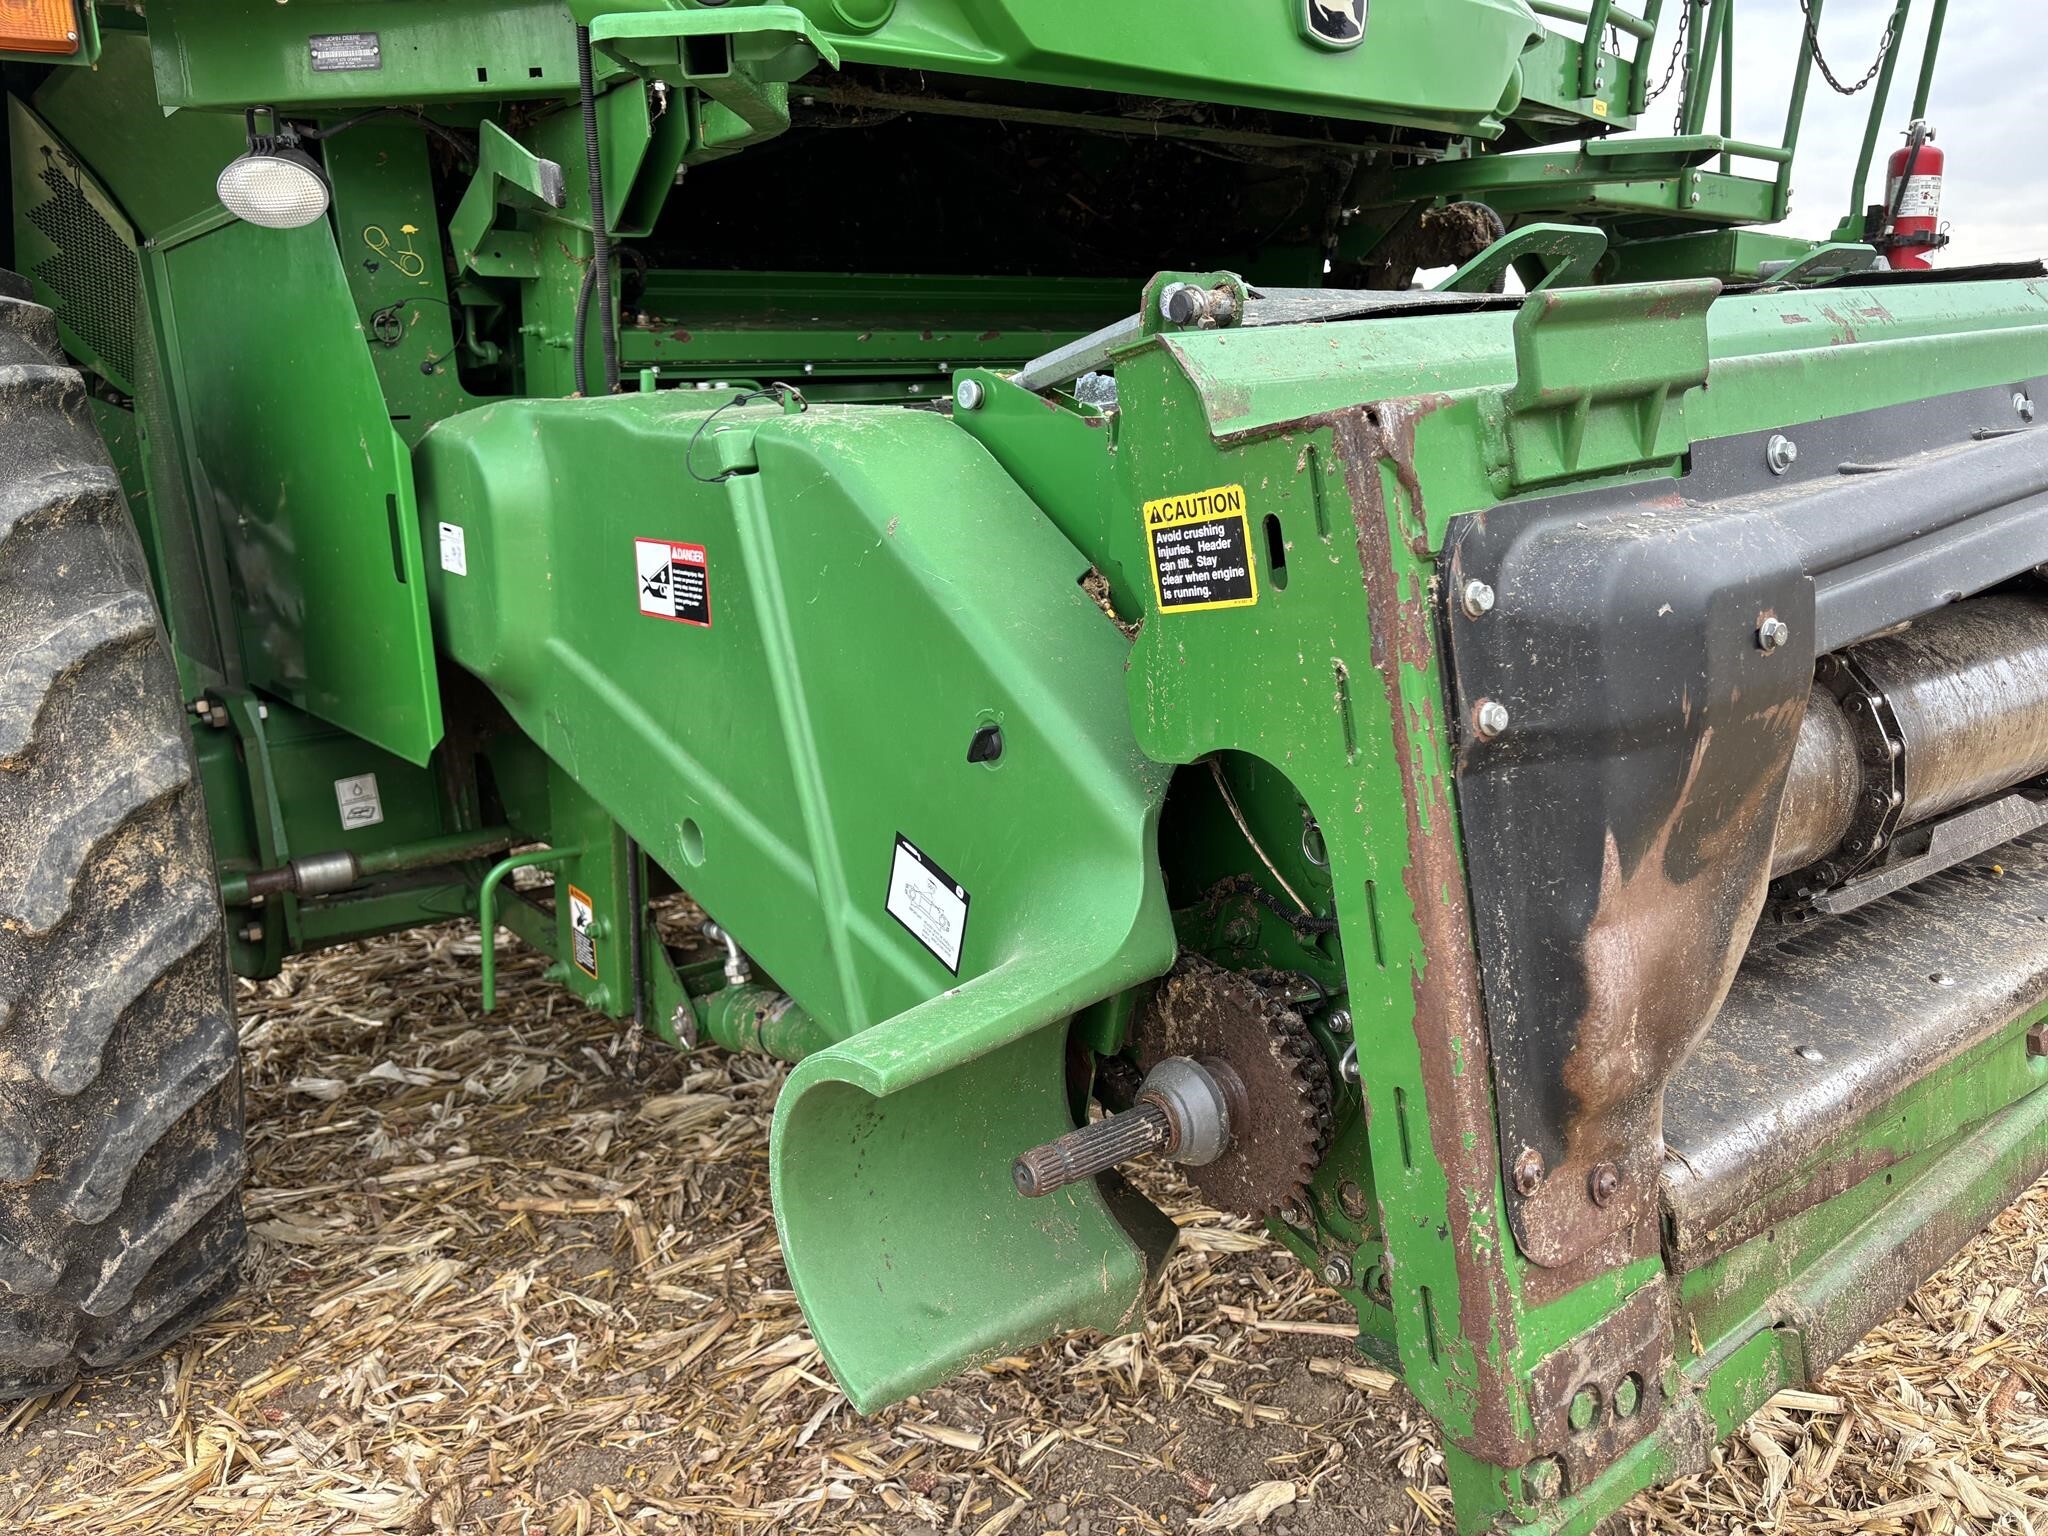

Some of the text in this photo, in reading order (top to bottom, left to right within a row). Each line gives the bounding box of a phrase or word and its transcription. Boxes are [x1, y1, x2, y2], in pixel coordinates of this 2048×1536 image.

[1162, 491, 1240, 521] CAUTION
[1156, 524, 1225, 544] Avoid crushing
[677, 548, 704, 562] DANGER
[1157, 538, 1232, 559] injuries. Header
[1160, 555, 1218, 572] can tilt. Stay
[1161, 566, 1245, 586] clear when engine
[1163, 585, 1212, 600] is running.
